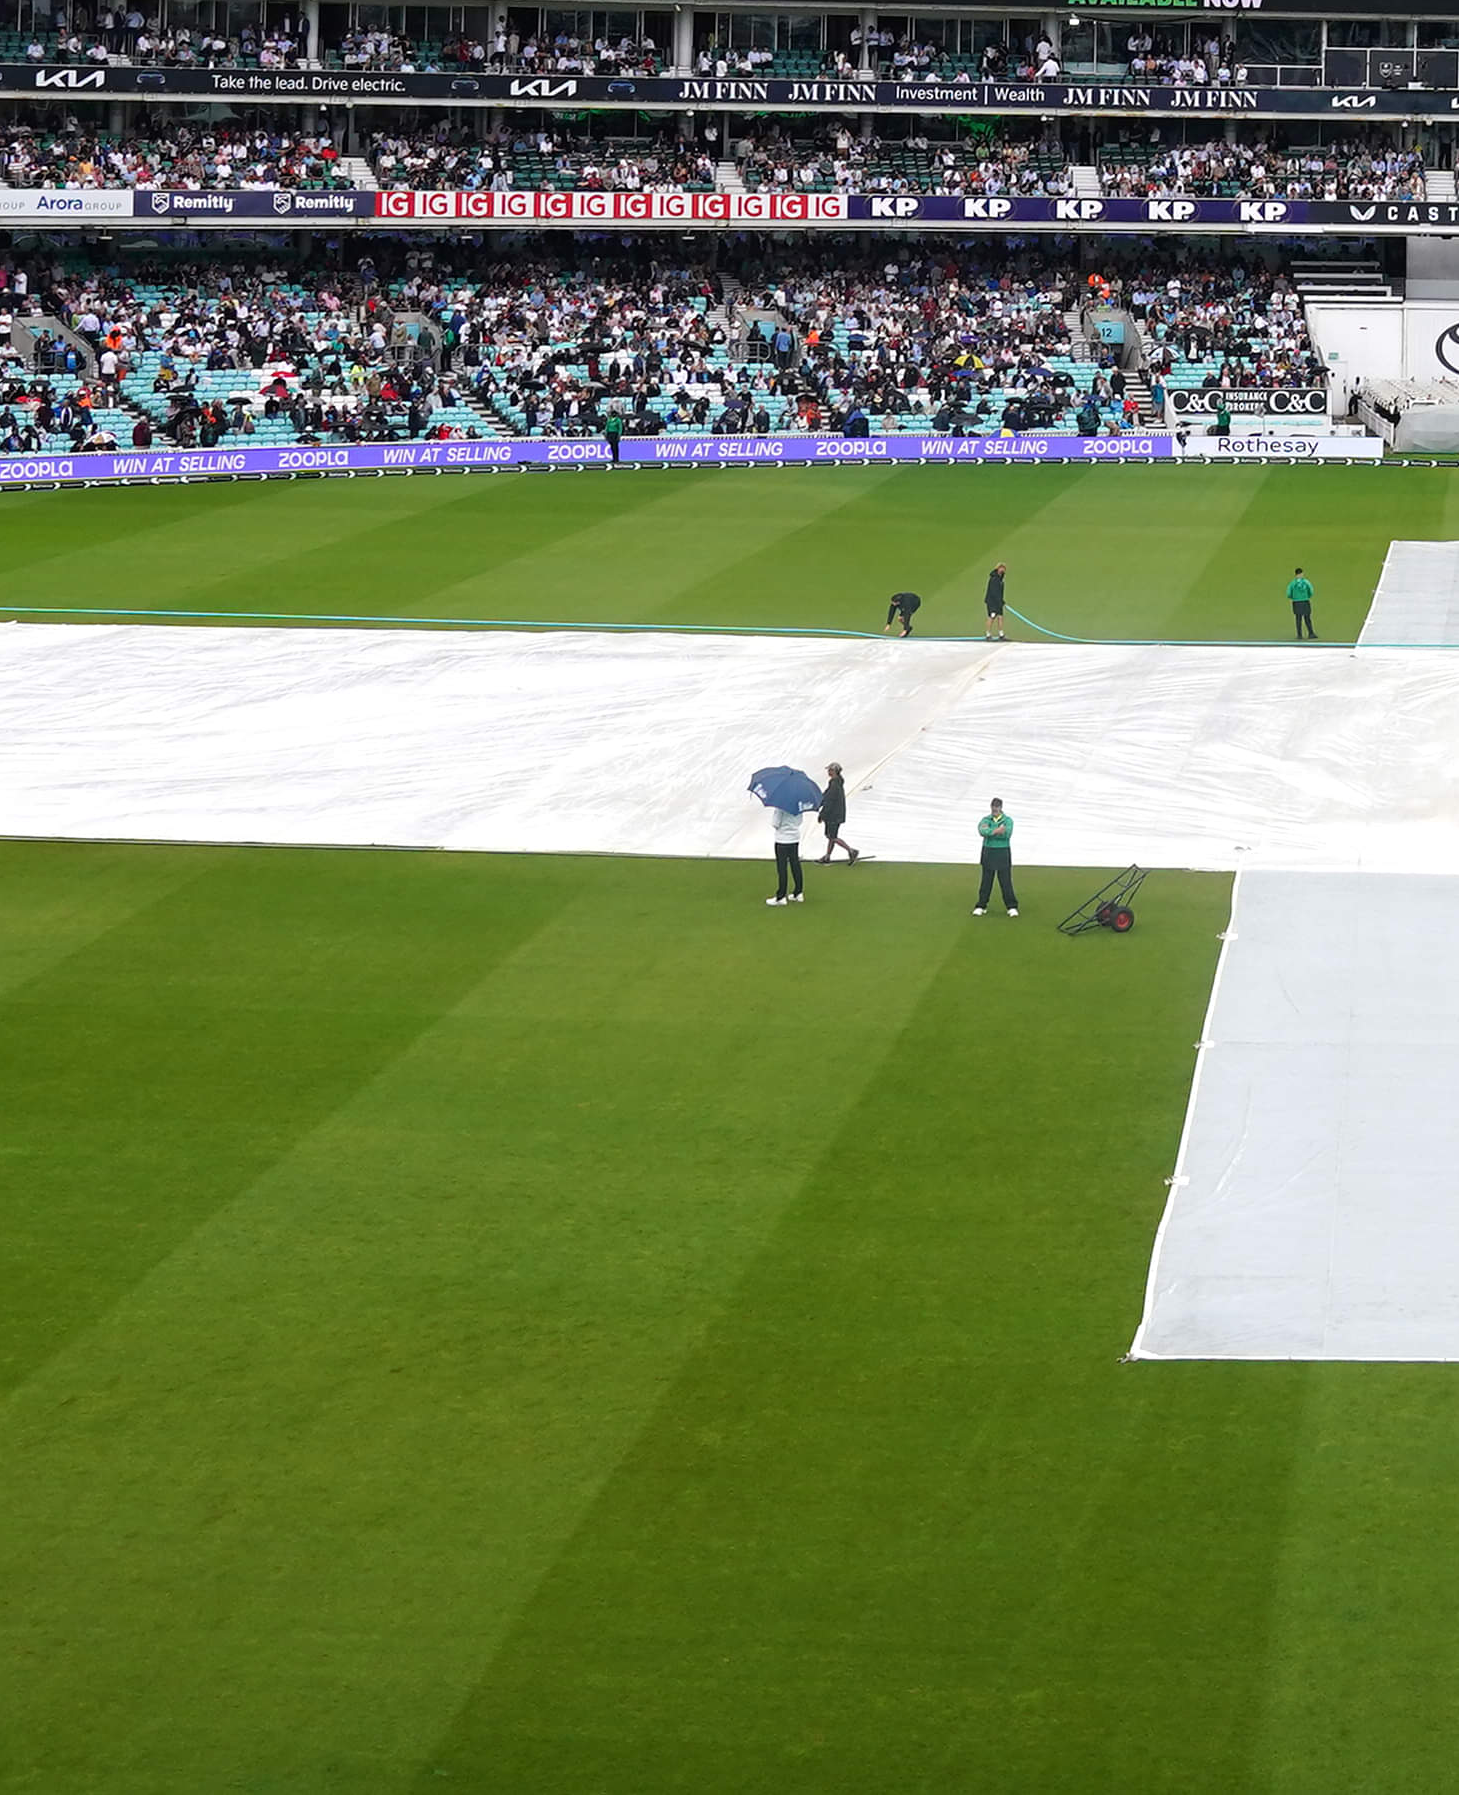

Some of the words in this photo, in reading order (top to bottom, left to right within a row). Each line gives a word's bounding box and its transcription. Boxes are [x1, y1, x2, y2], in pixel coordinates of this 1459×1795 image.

[212, 75, 245, 89] Take
[249, 75, 272, 89] the
[275, 76, 308, 90] lead.
[312, 77, 349, 91] Drive
[352, 77, 406, 92] electric.
[679, 82, 710, 99] JM
[716, 83, 768, 100] FINN
[788, 83, 819, 101] JM
[825, 84, 877, 101] FINN
[896, 86, 978, 102] Investment
[994, 87, 1045, 102] Wealth
[1063, 88, 1094, 105] JM
[1101, 89, 1151, 105] FINN
[36, 195, 83, 210] Arora
[84, 202, 123, 211] GROUP
[173, 195, 234, 212] Remitly
[295, 195, 355, 212] Remitly
[381, 192, 409, 216] IG
[423, 194, 449, 215] IG
[461, 193, 489, 216] IG
[502, 194, 527, 215] IG
[539, 194, 568, 217] IG
[620, 195, 648, 218] IG
[698, 196, 726, 218] IG
[816, 197, 840, 218] IG
[1101, 327, 1112, 338] 12
[1170, 391, 1223, 412] C&C
[1269, 391, 1325, 412] C&C
[922, 438, 953, 454] WIN
[958, 438, 980, 453] AT
[984, 437, 1049, 454] SELLING
[1218, 437, 1319, 455] Rothesay
[384, 448, 416, 464] WIN
[420, 447, 442, 462] AT
[446, 446, 511, 462] SELLING
